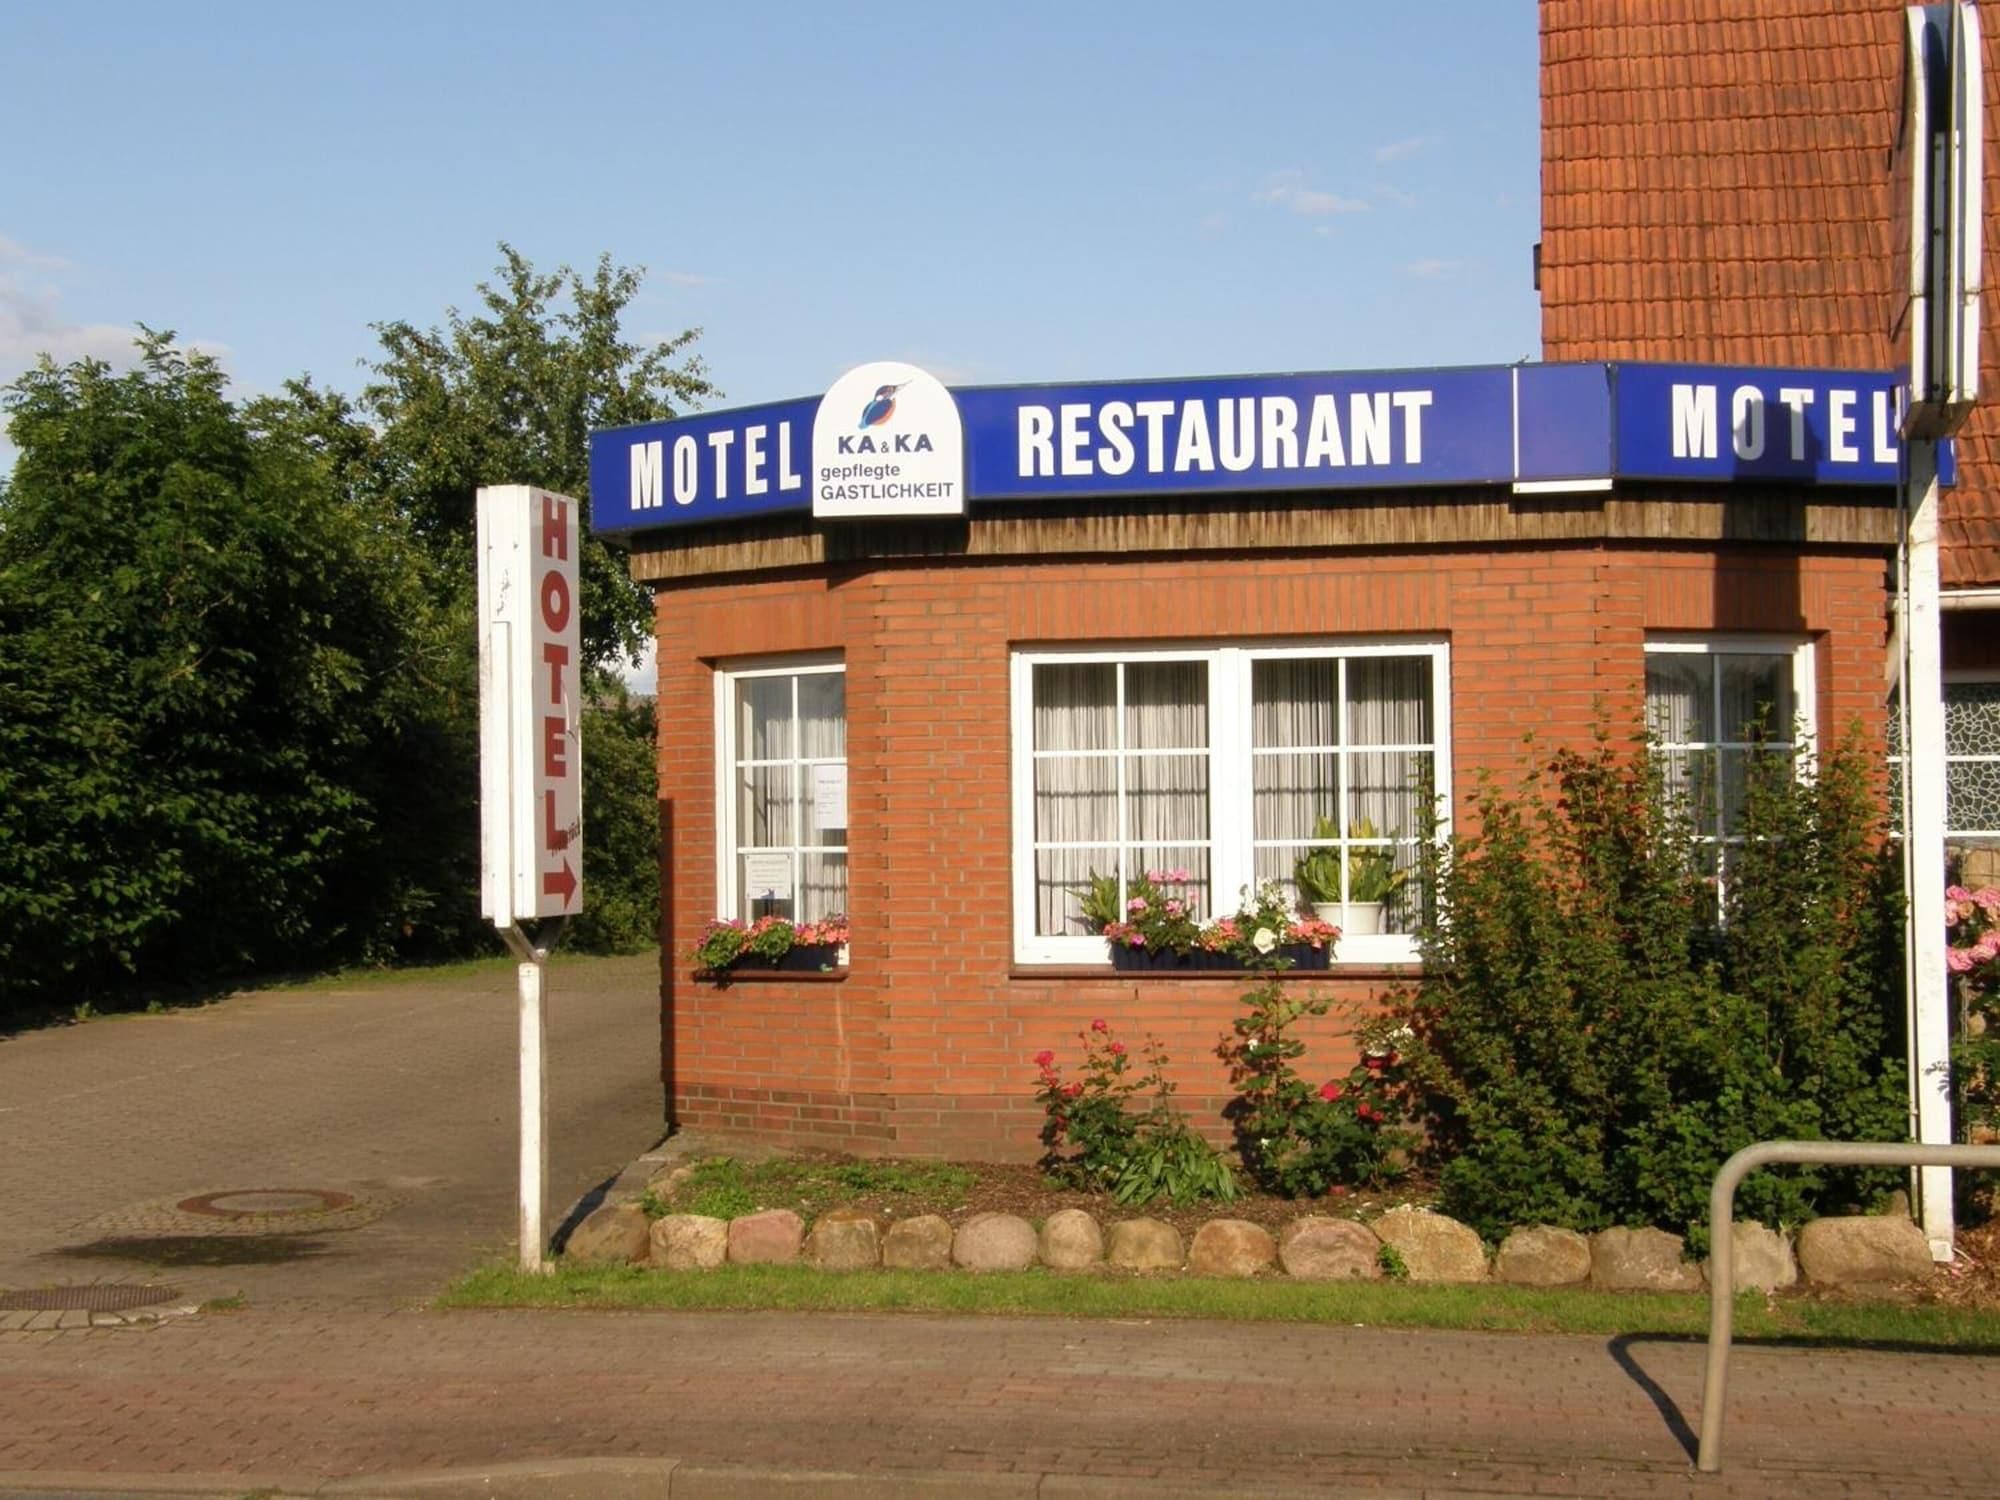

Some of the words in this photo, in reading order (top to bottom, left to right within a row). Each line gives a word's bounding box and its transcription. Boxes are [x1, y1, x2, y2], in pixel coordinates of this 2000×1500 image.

[1018, 390, 1433, 478] RESTAURANT
[1671, 384, 1898, 463] MOTEL
[630, 421, 801, 511] MOTEL
[820, 464, 901, 481] gepflegte
[820, 482, 954, 500] GASTLICHKEIT
[541, 496, 570, 851] HOTEL
